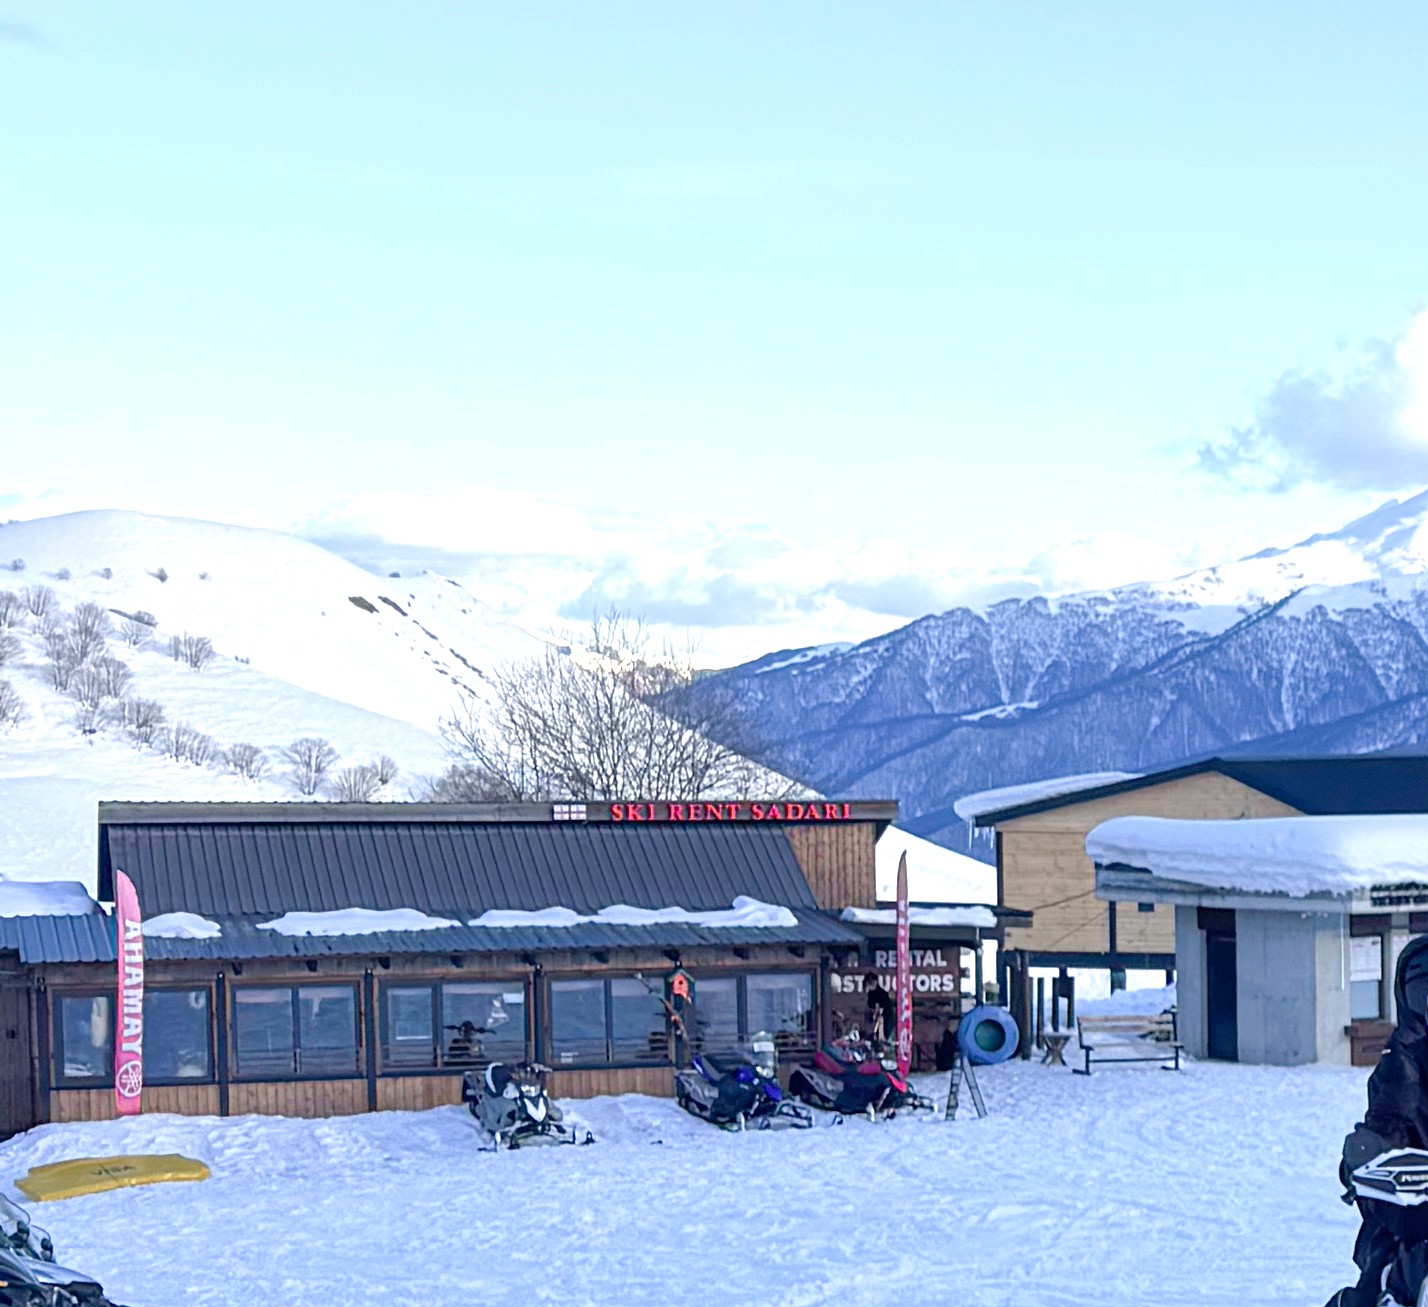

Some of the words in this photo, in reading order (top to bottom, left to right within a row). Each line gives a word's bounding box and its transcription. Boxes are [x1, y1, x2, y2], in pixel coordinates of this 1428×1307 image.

[610, 804, 655, 821] SKI
[668, 803, 741, 820] RENT
[751, 803, 850, 820] SADARI
[876, 949, 947, 968] RETAL
[831, 974, 954, 993] STUORS
